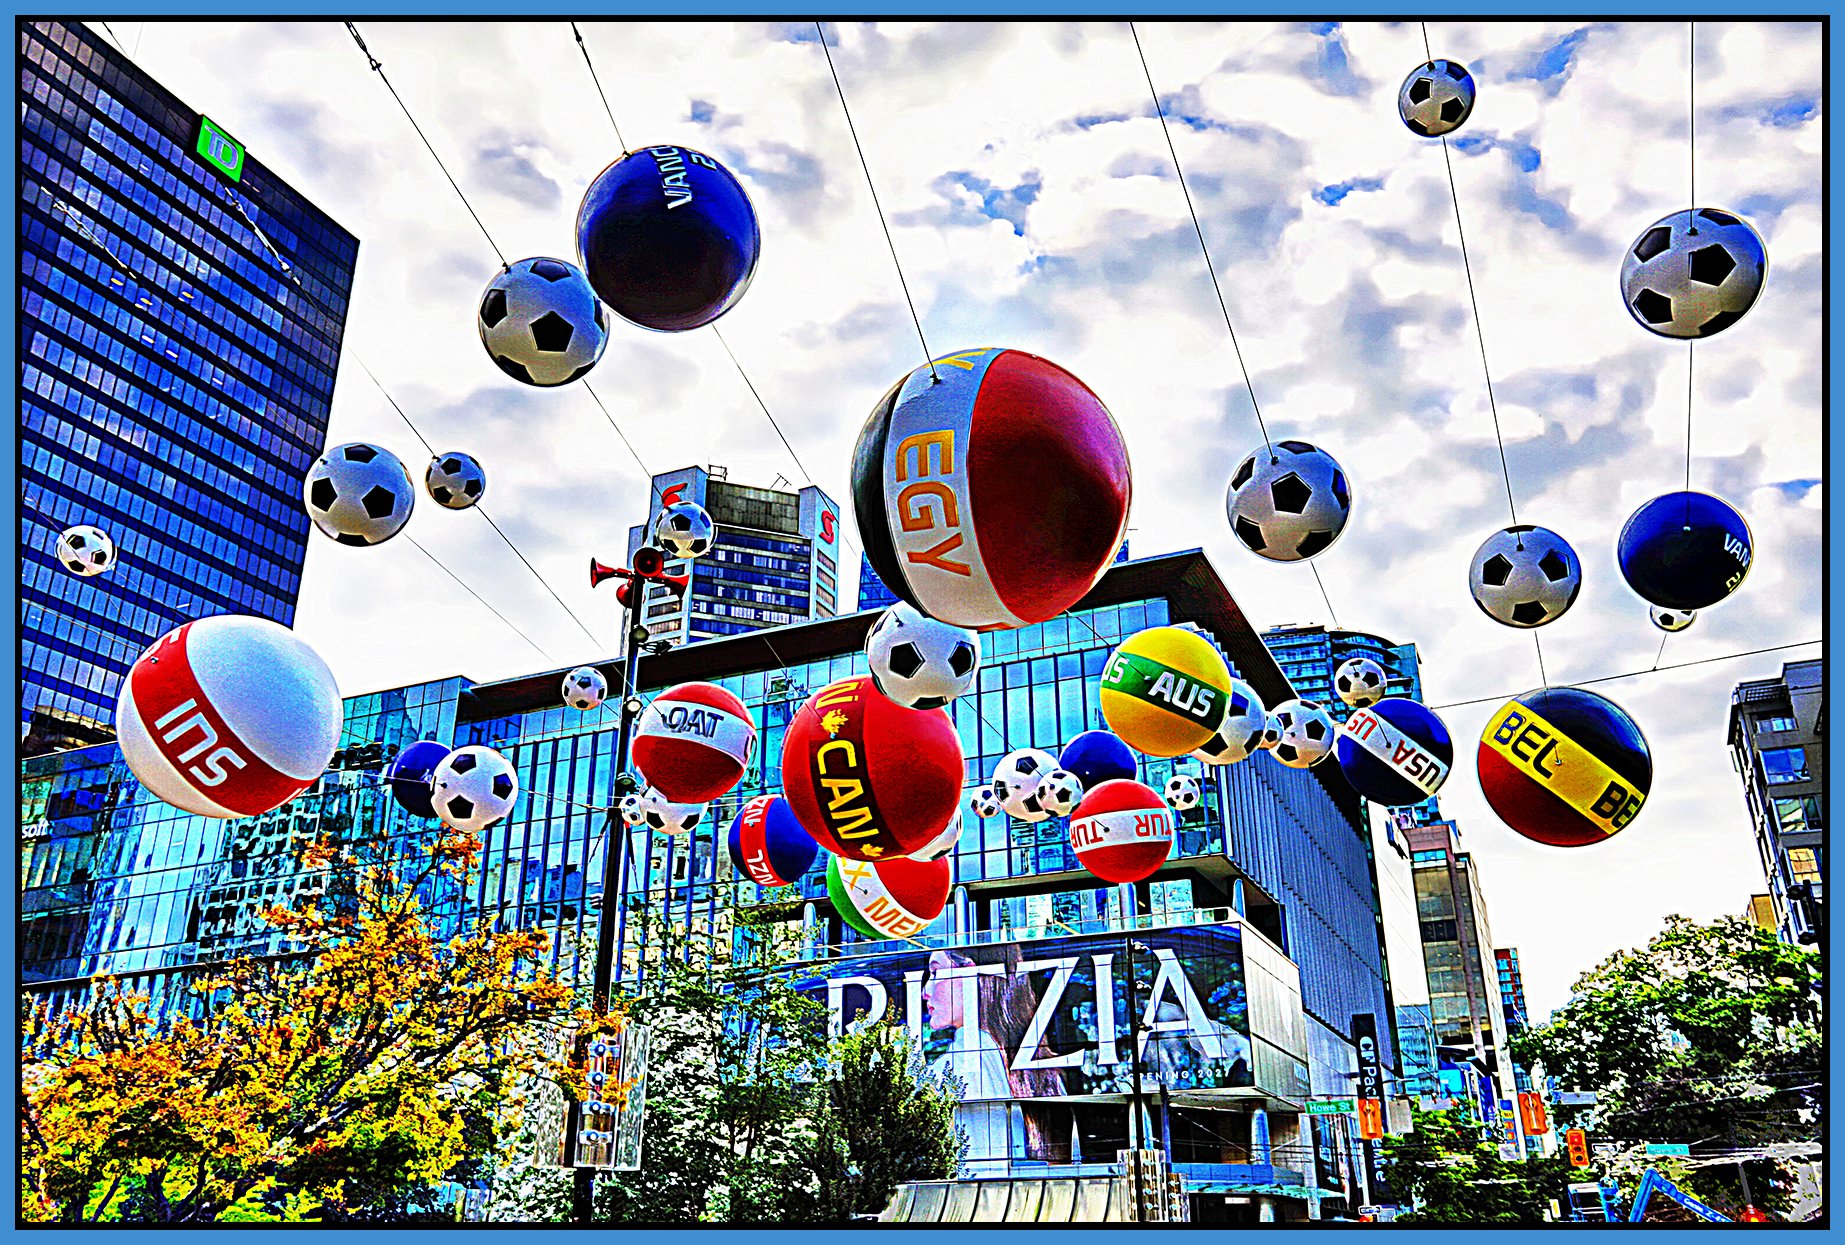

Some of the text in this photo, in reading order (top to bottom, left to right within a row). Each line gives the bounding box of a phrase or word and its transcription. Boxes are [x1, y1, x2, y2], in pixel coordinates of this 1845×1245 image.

[204, 124, 239, 170] TD
[894, 429, 972, 578] EGY
[1147, 671, 1216, 718] AUS
[667, 706, 725, 739] QAT
[1493, 710, 1561, 780] BEL
[1391, 738, 1441, 788] USA
[817, 739, 880, 840] CAN
[746, 849, 778, 885] NZL
[793, 948, 1228, 1084] RITZIA
[1309, 1101, 1351, 1113] Howe St
